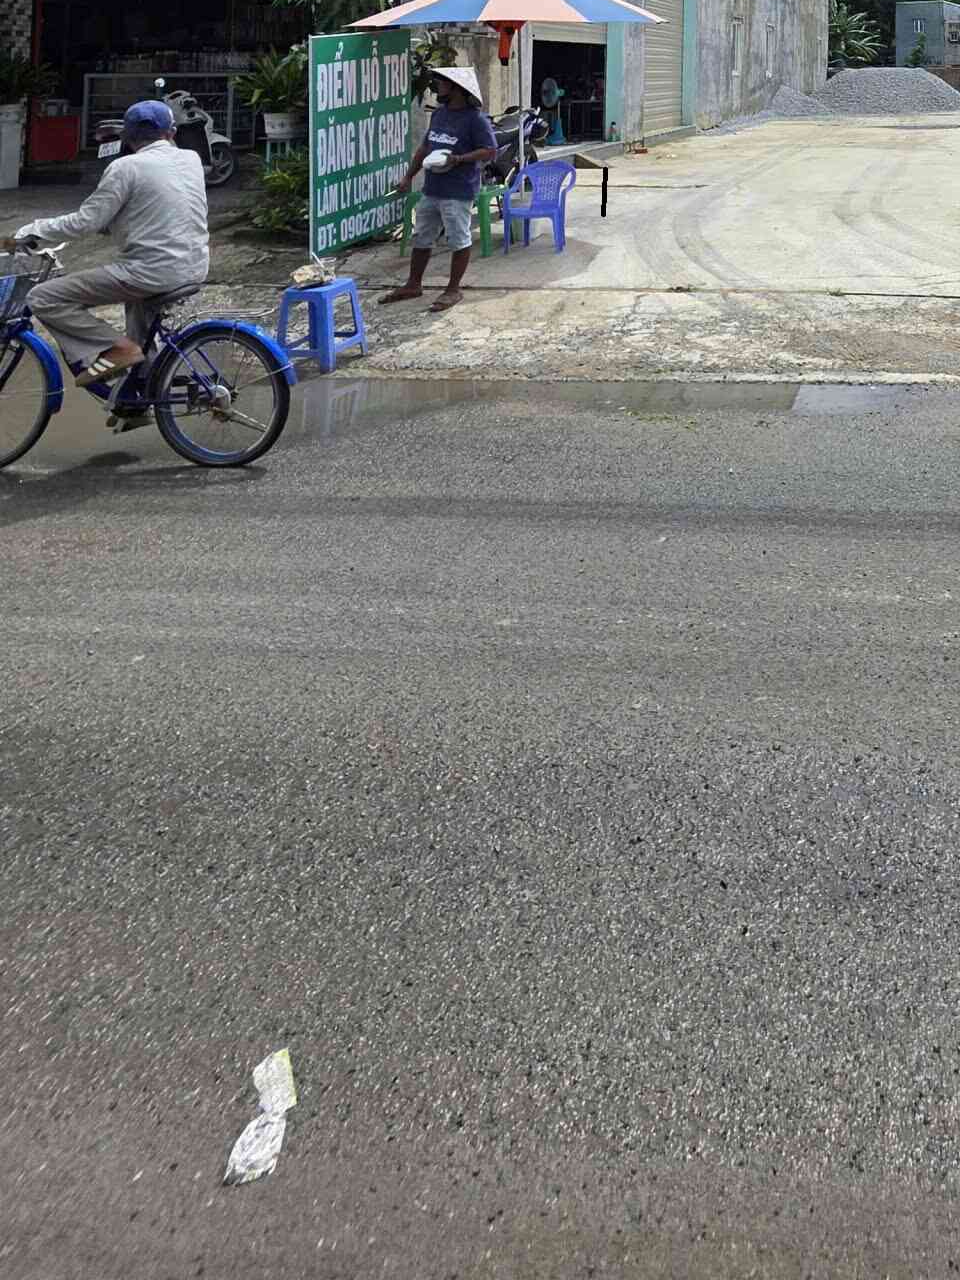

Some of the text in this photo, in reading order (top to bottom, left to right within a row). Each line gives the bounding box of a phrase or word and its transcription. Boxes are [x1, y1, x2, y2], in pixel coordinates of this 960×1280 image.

[317, 40, 409, 112] ĐIỂM HỖ TRỢ
[317, 115, 355, 177] ĐĂNG
[358, 107, 375, 165] KÝ
[341, 172, 352, 210] LÝ
[354, 171, 374, 210] LỊCH
[317, 223, 337, 252] ĐT:
